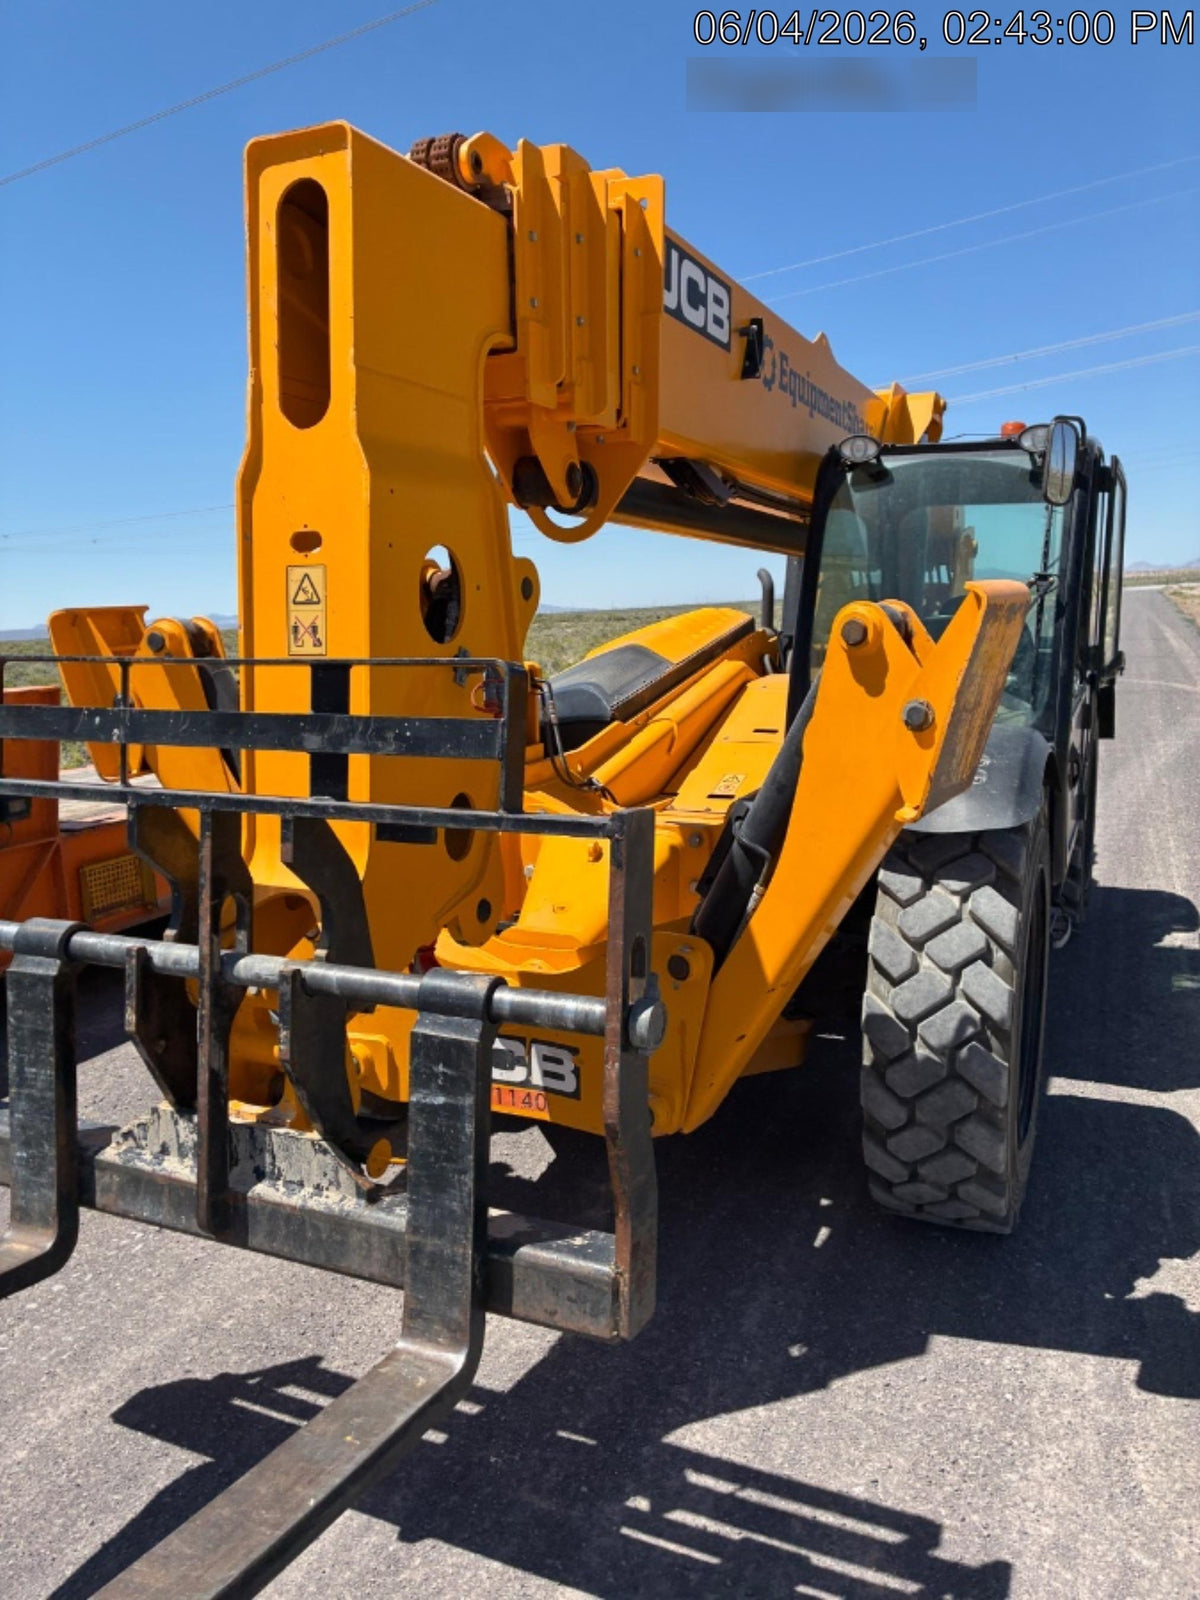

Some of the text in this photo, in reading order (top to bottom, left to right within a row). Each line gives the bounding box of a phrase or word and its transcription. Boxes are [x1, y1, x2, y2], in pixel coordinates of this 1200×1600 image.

[664, 248, 729, 344] JCB
[779, 350, 874, 435] EquipmentSha
[492, 1037, 577, 1092] CB
